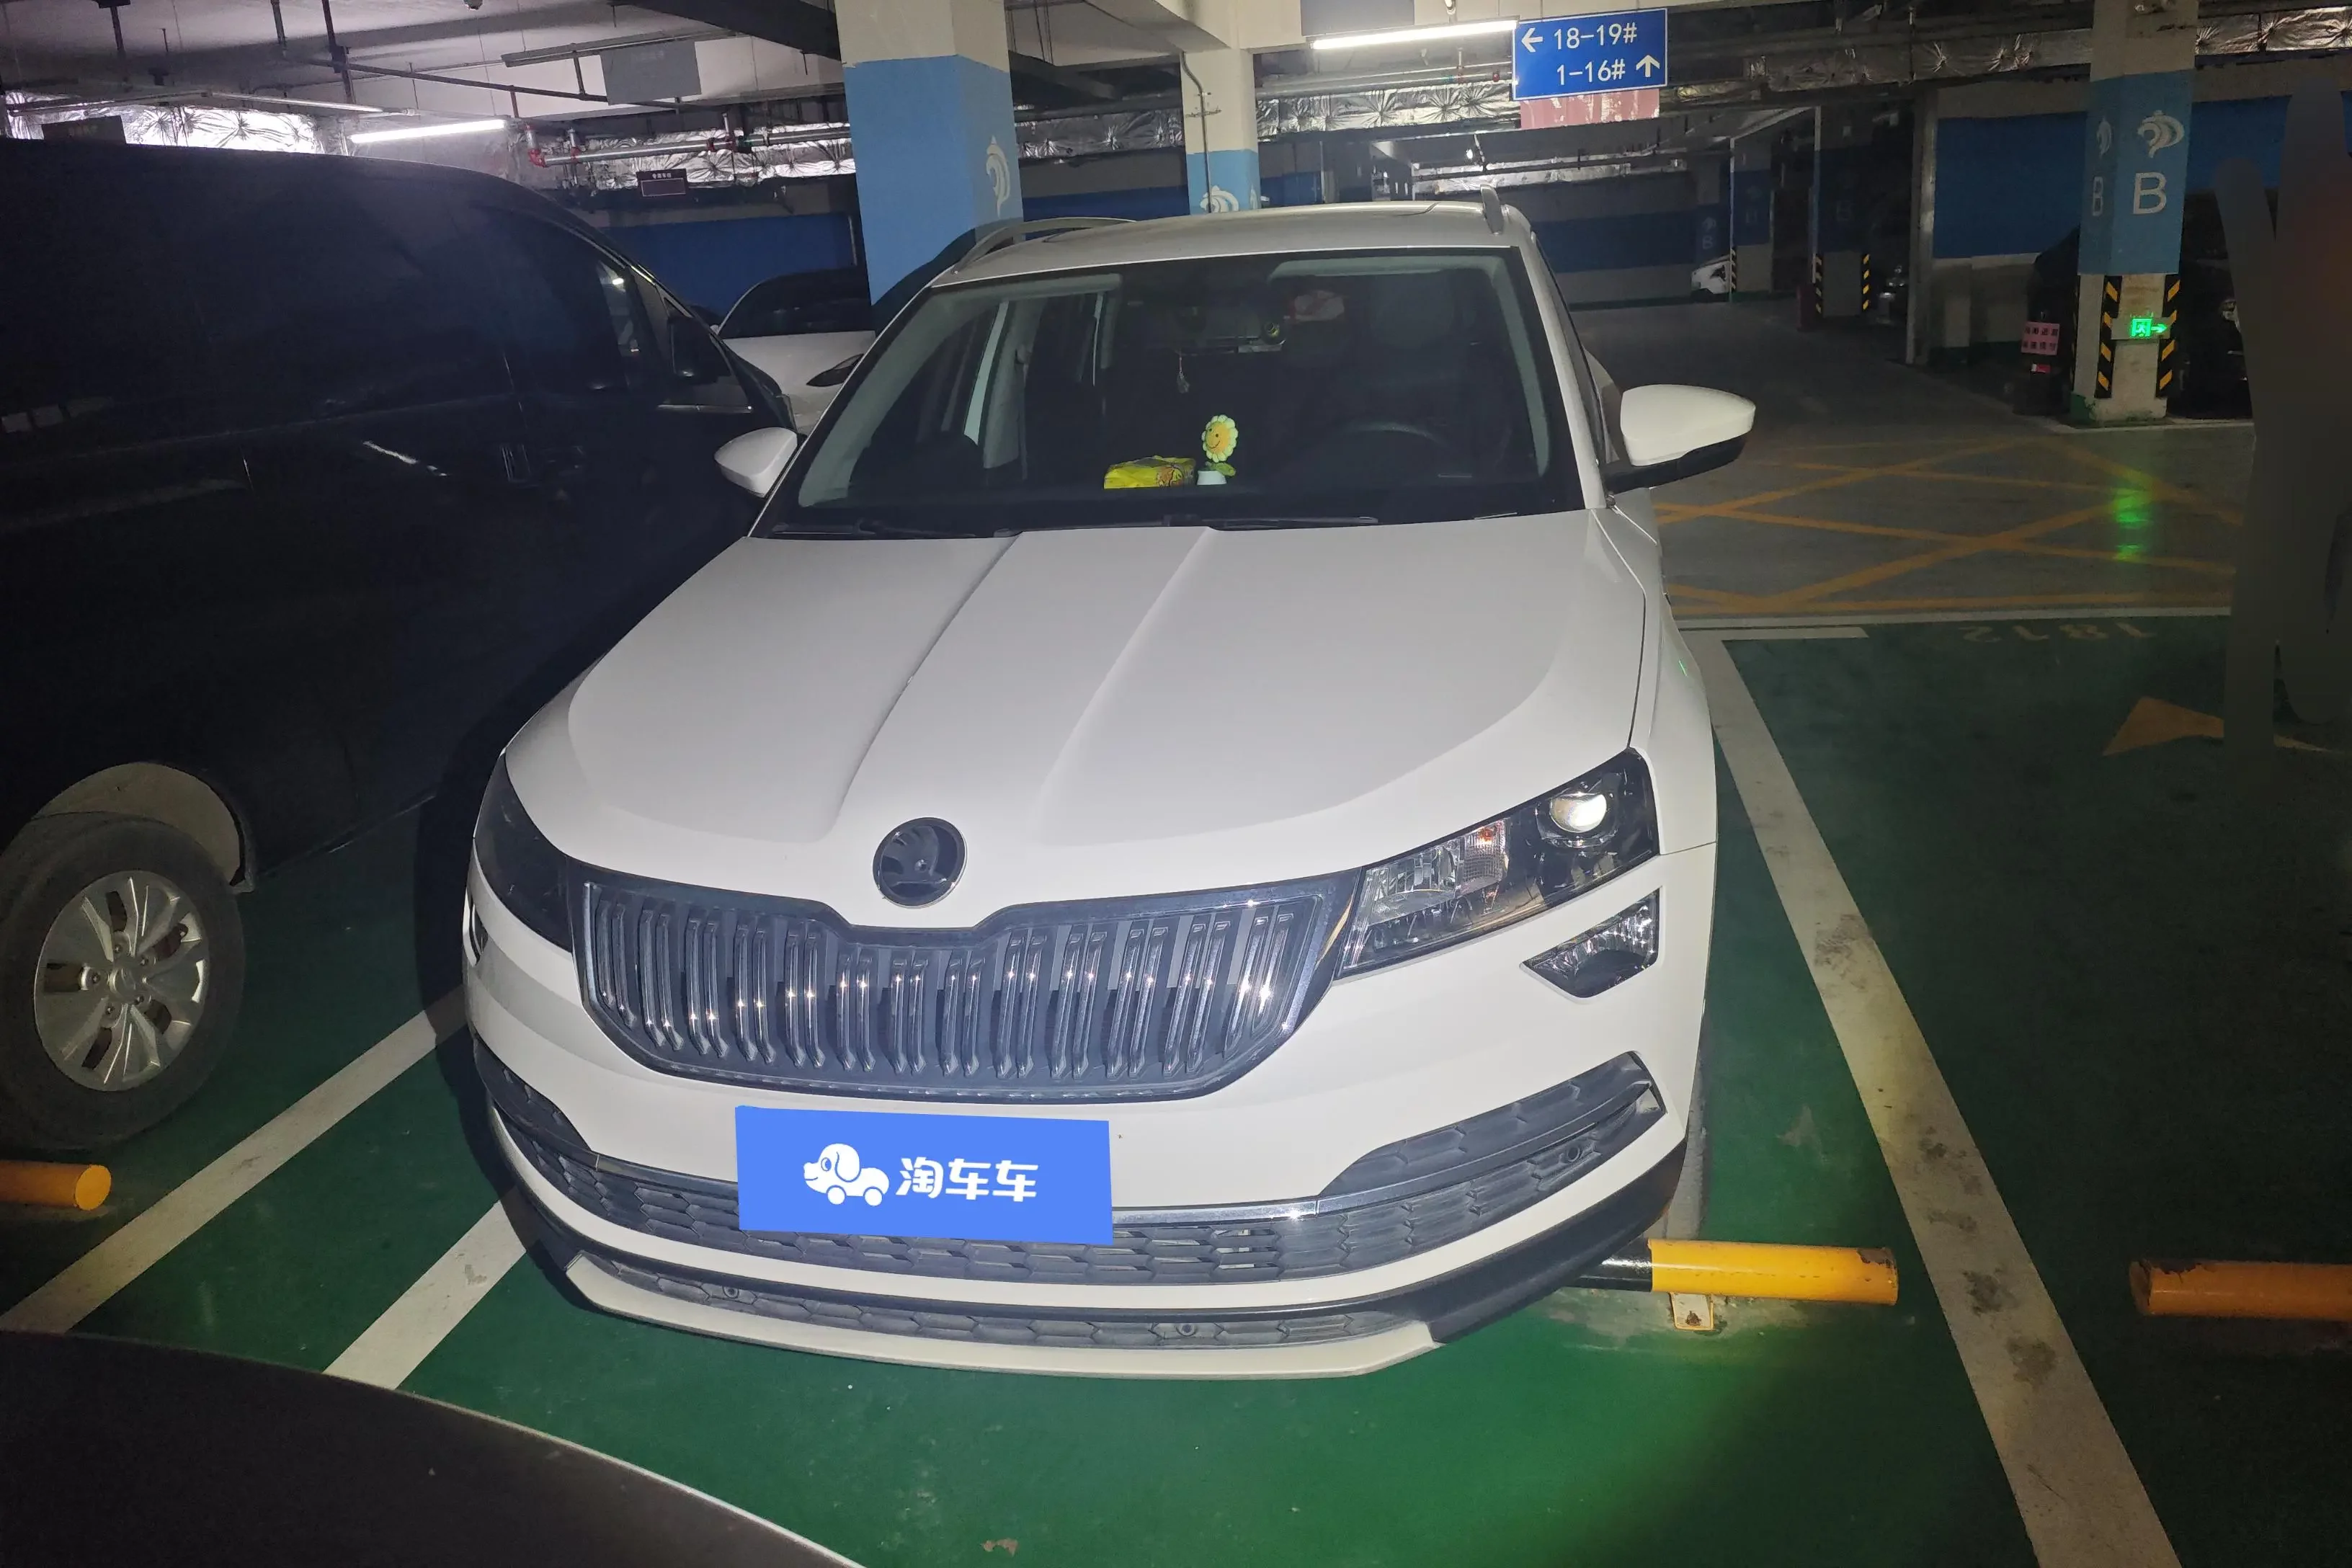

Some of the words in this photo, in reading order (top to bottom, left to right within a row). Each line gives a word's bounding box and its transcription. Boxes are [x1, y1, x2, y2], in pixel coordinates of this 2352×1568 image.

[1554, 22, 1637, 50] 18-19#
[1556, 58, 1626, 85] 1-16#
[2132, 172, 2168, 215] B
